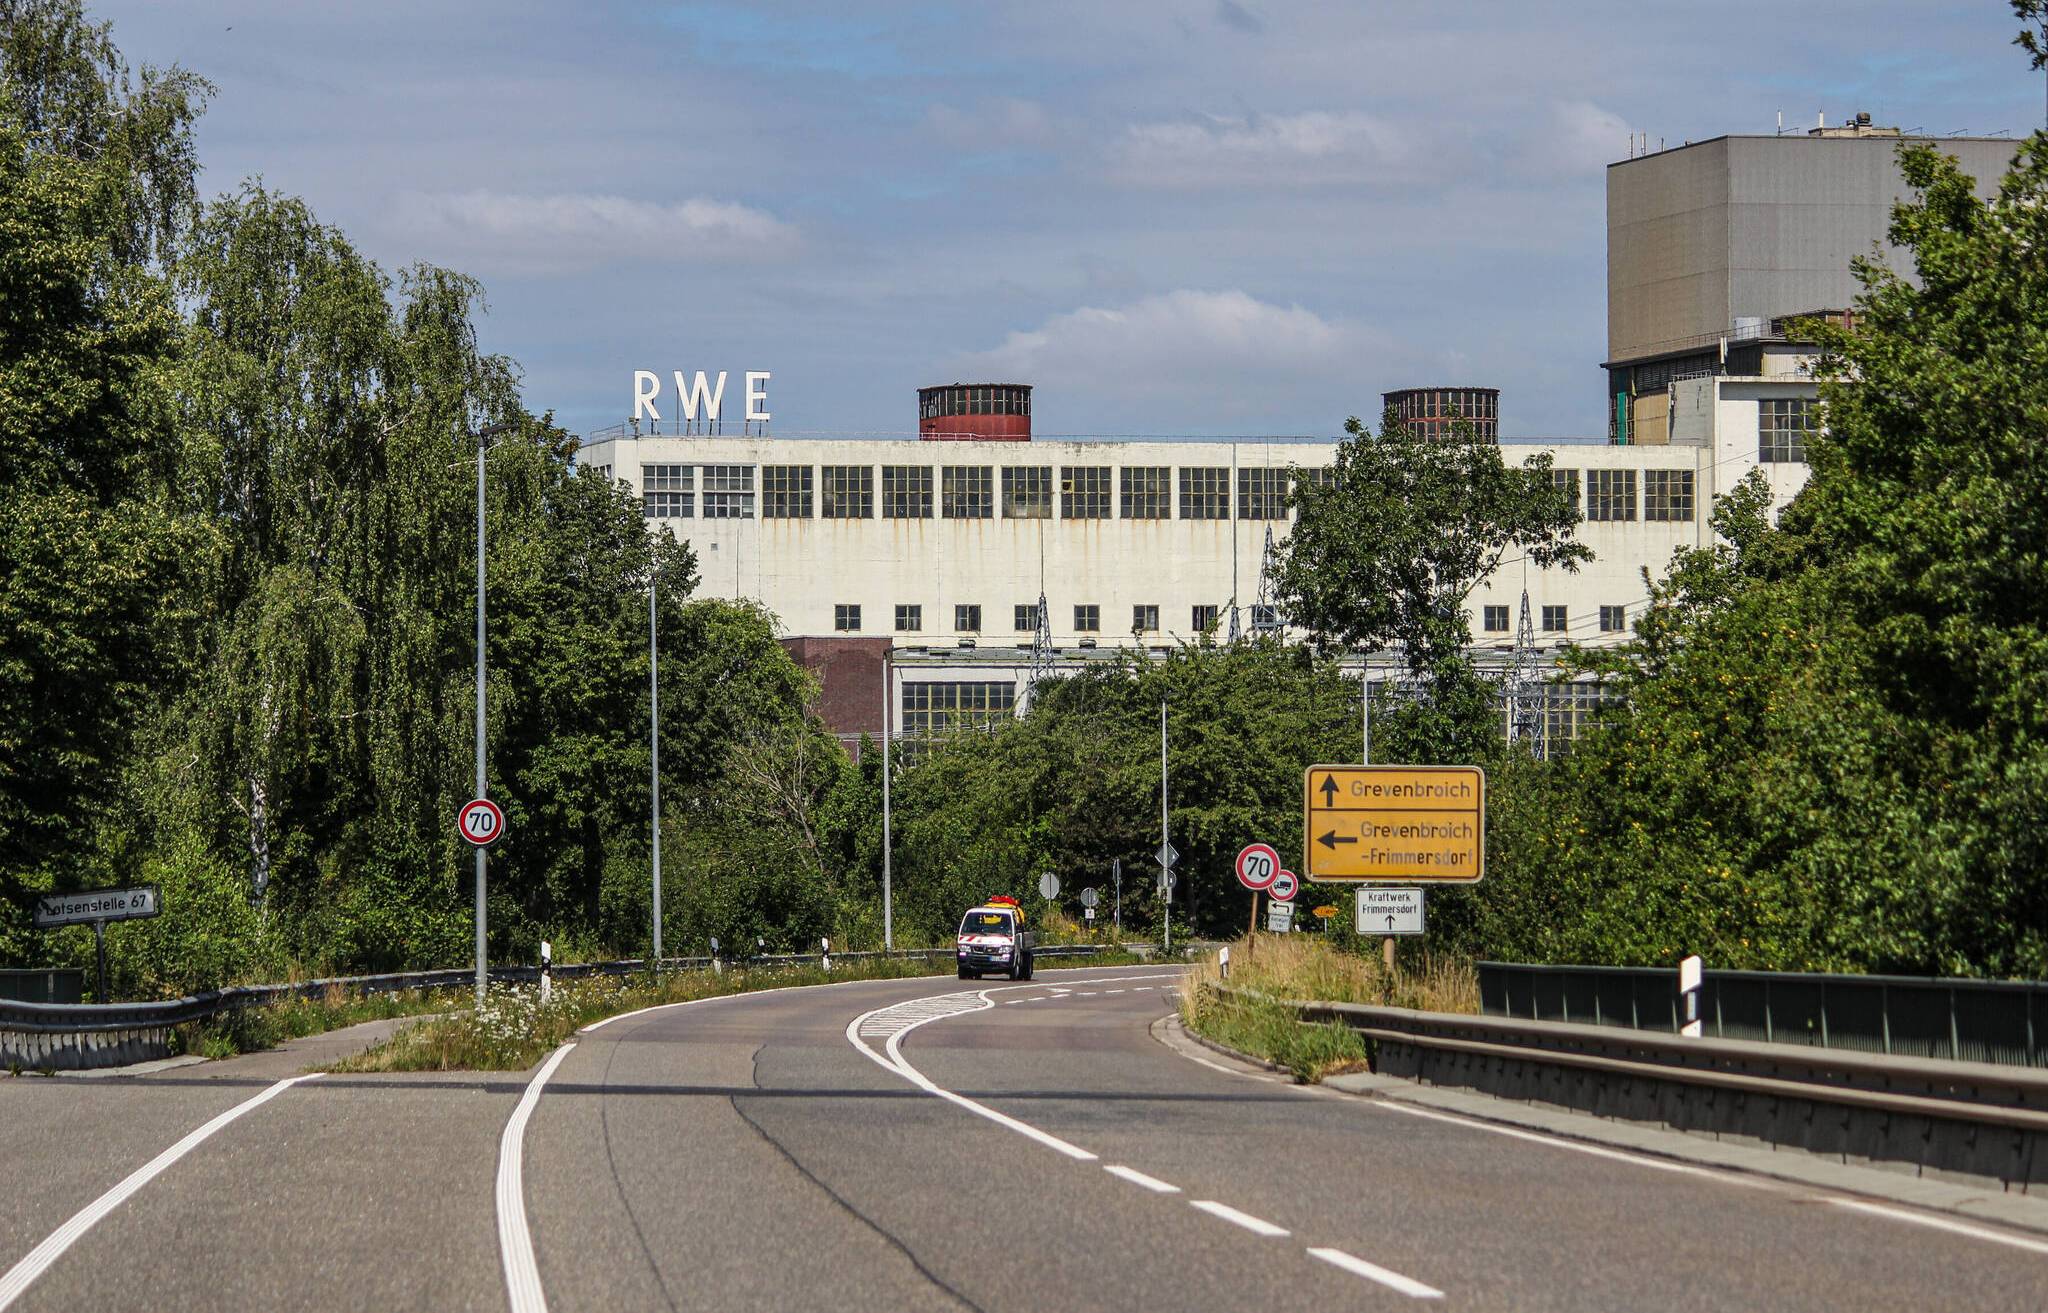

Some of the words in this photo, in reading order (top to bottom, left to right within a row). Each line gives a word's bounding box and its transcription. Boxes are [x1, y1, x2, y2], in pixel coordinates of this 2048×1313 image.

[634, 370, 771, 420] RWE
[1351, 780, 1470, 798] Grevenbroich
[470, 813, 492, 831] 70
[1360, 821, 1473, 839] Grevenbroich
[1361, 847, 1473, 865] -Frimmersdorf
[1248, 856, 1271, 878] 70
[131, 895, 146, 907] 67
[1368, 892, 1411, 902] Kraftwerk
[1362, 904, 1417, 914] Frimmersdorf
